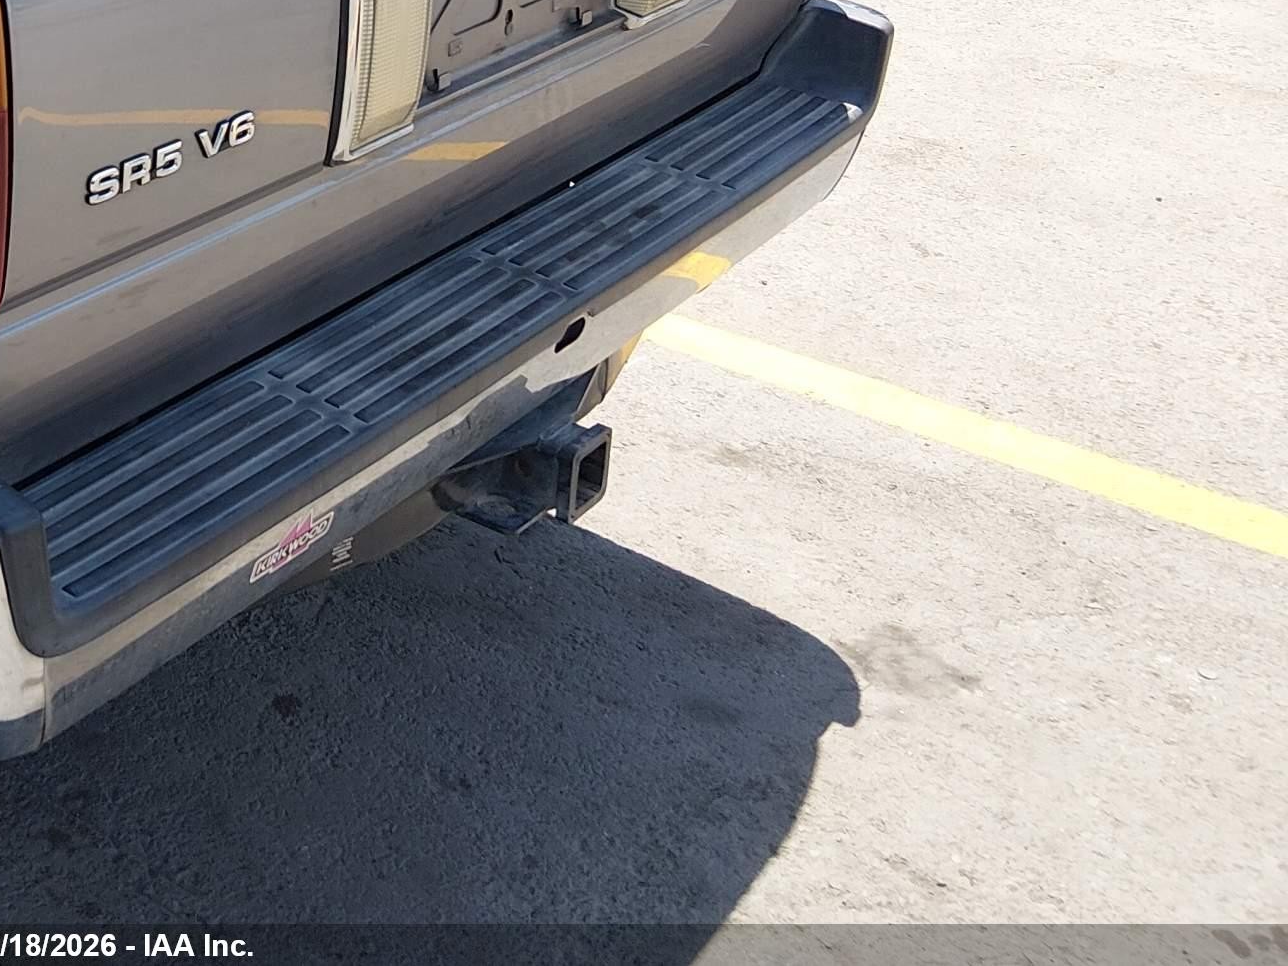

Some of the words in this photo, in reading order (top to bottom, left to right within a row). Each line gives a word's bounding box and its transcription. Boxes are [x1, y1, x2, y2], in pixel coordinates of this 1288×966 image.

[85, 139, 183, 206] SR5
[194, 110, 255, 159] V6
[255, 519, 330, 575] KIRKWOOD
